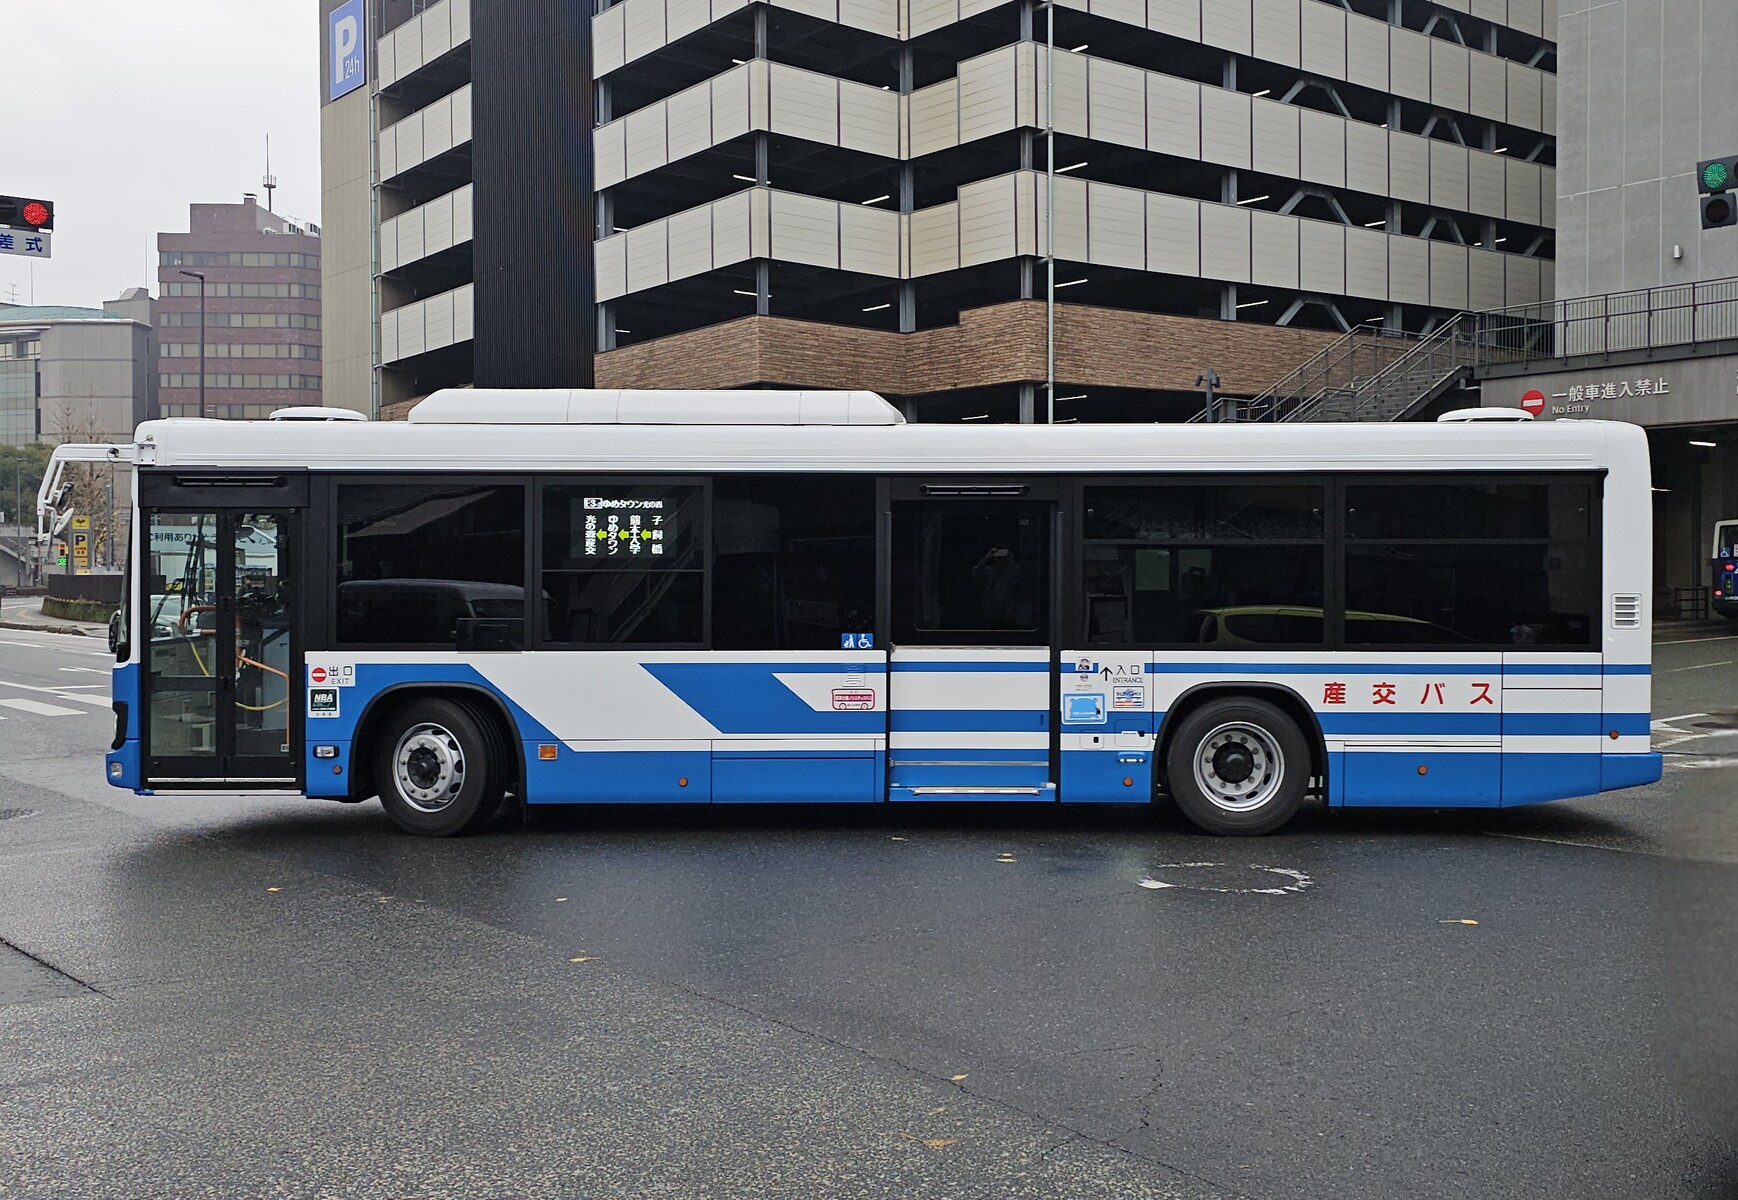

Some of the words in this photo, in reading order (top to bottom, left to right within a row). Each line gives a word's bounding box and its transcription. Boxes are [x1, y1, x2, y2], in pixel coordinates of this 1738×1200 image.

[335, 15, 357, 84] P
[345, 56, 360, 79] 24h
[1552, 377, 1669, 402] 一般車進入禁止
[1552, 405, 1564, 414] No
[1567, 404, 1590, 414] Entry
[75, 535, 86, 545] P
[608, 515, 619, 555] ゆめタウン
[329, 666, 353, 677] 出口
[1116, 664, 1140, 675] 入口
[314, 693, 334, 703] NBA
[1323, 682, 1494, 705] 産交バス
